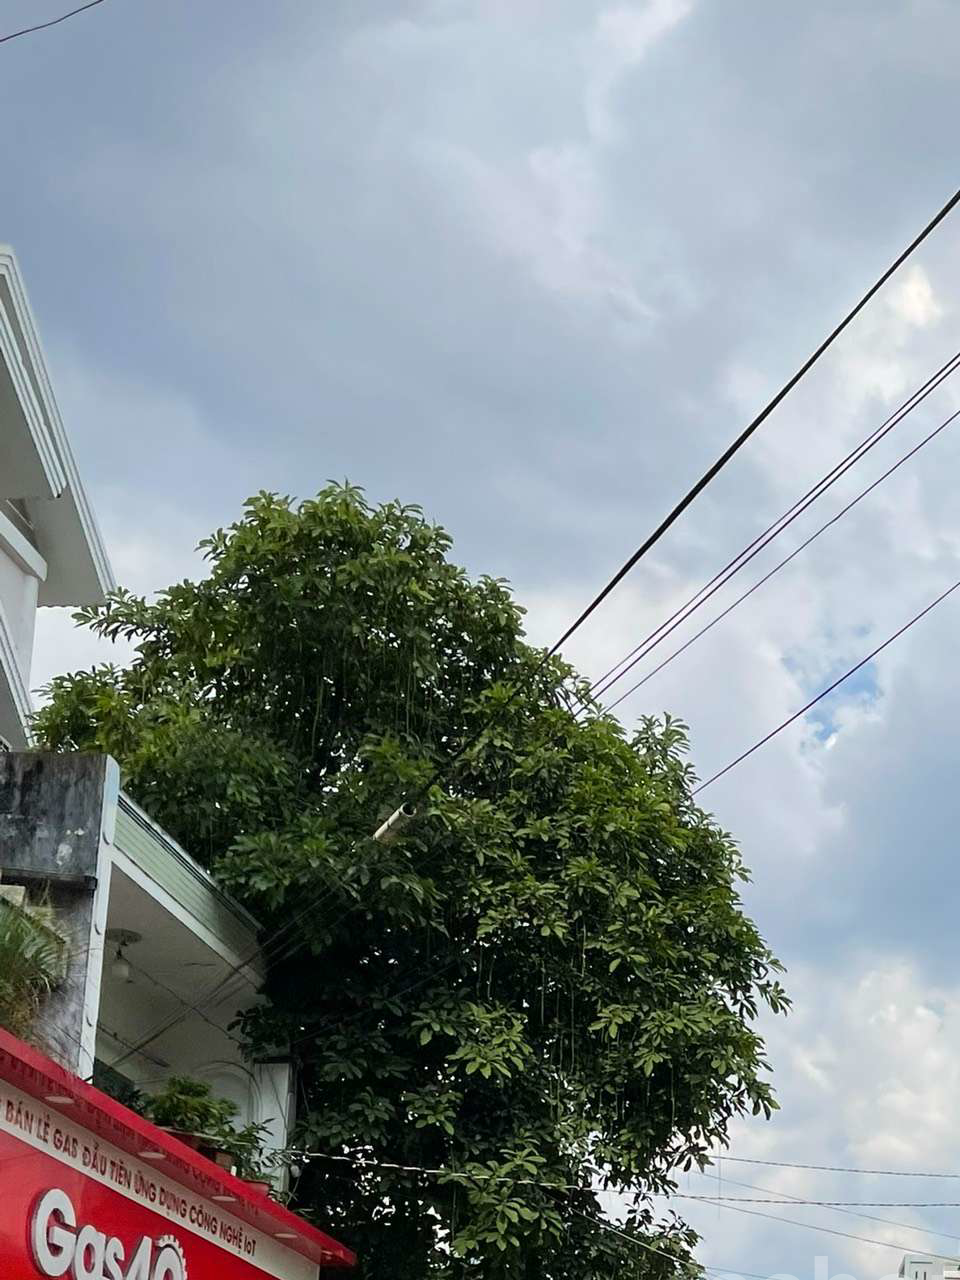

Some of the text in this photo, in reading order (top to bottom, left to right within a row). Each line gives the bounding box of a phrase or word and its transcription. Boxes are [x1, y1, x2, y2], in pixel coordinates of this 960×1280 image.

[6, 1099, 33, 1134] BÁN
[53, 1128, 79, 1158] GAS
[189, 1204, 218, 1235] CÔNG
